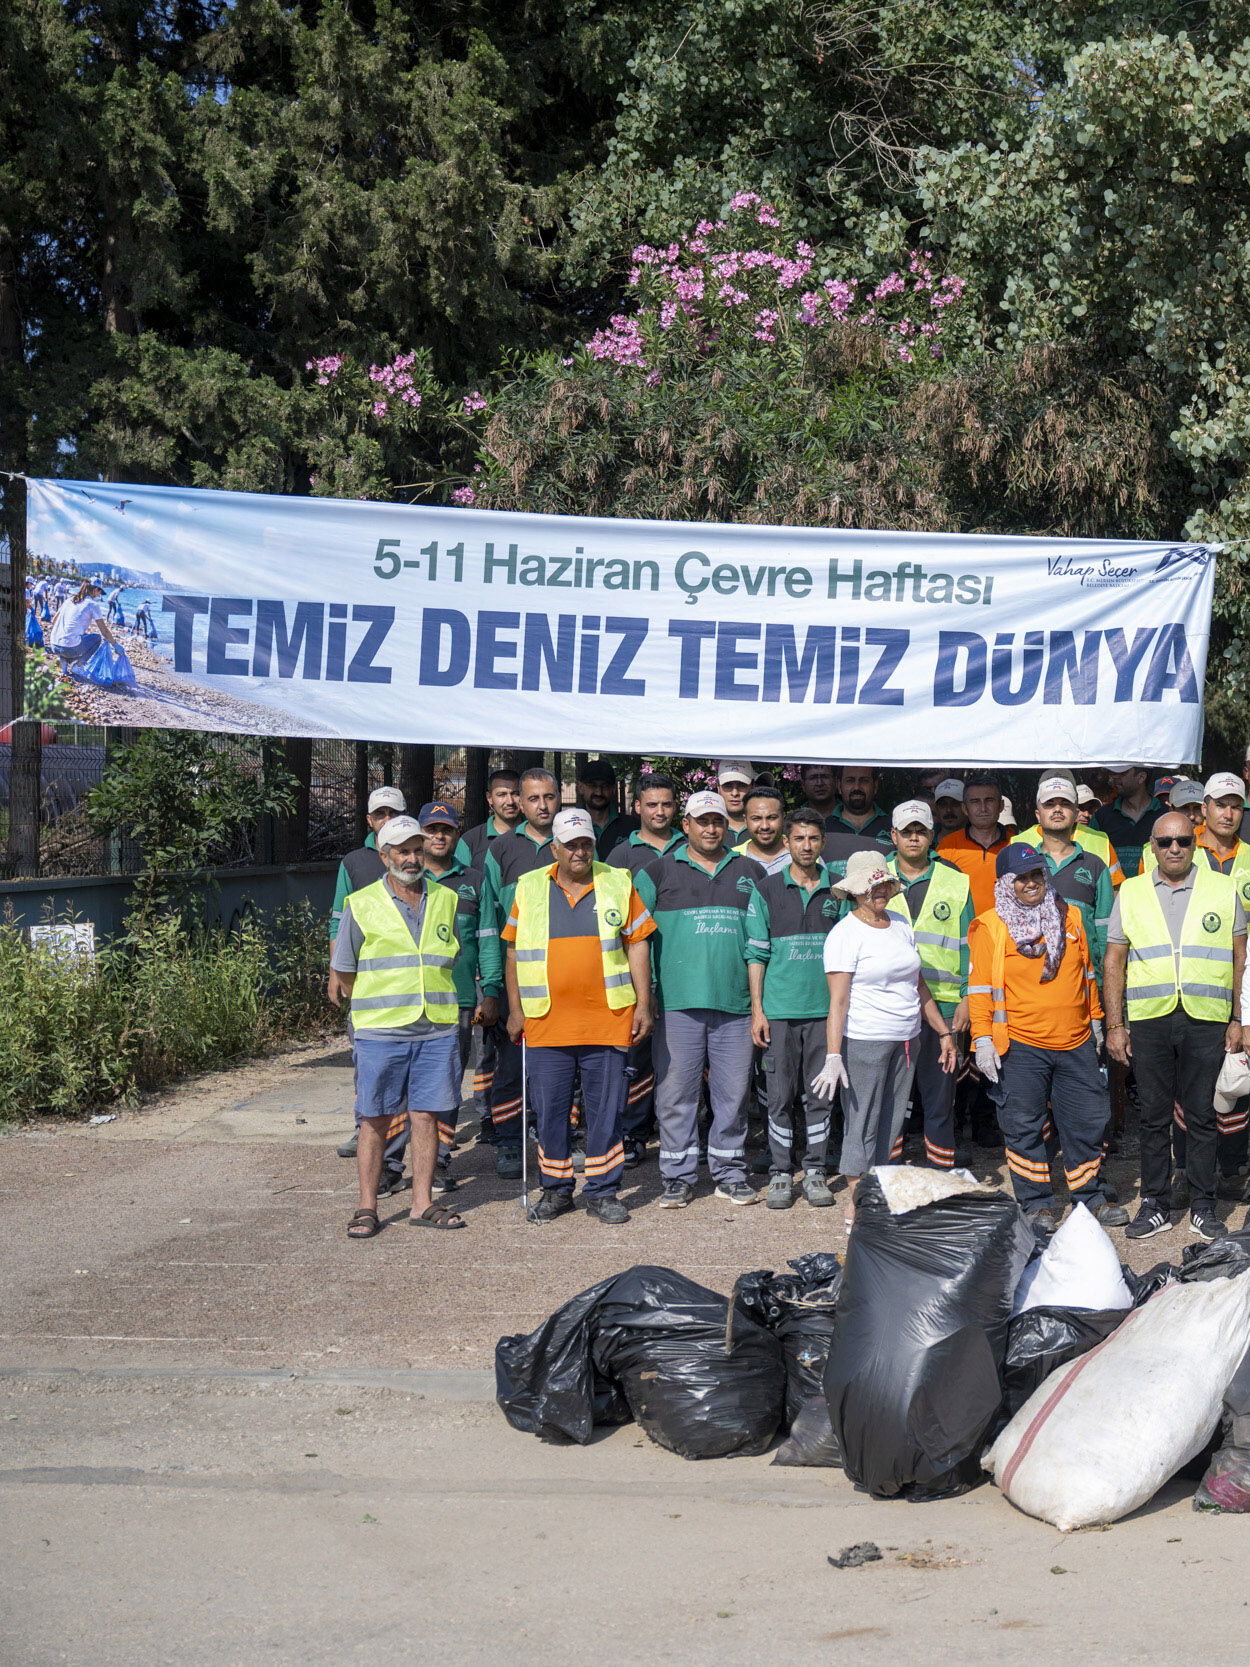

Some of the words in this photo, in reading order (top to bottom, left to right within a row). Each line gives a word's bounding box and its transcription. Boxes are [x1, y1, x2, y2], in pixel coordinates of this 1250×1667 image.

[373, 538, 464, 582] 5-11
[484, 542, 657, 592] Haziran
[675, 551, 812, 605] Çevre
[828, 558, 993, 605] Haftası
[1047, 555, 1094, 586] Vahap
[1098, 558, 1138, 578] Seçer
[933, 622, 1199, 708] DÜNYA
[788, 946, 824, 963] İlaçlam
